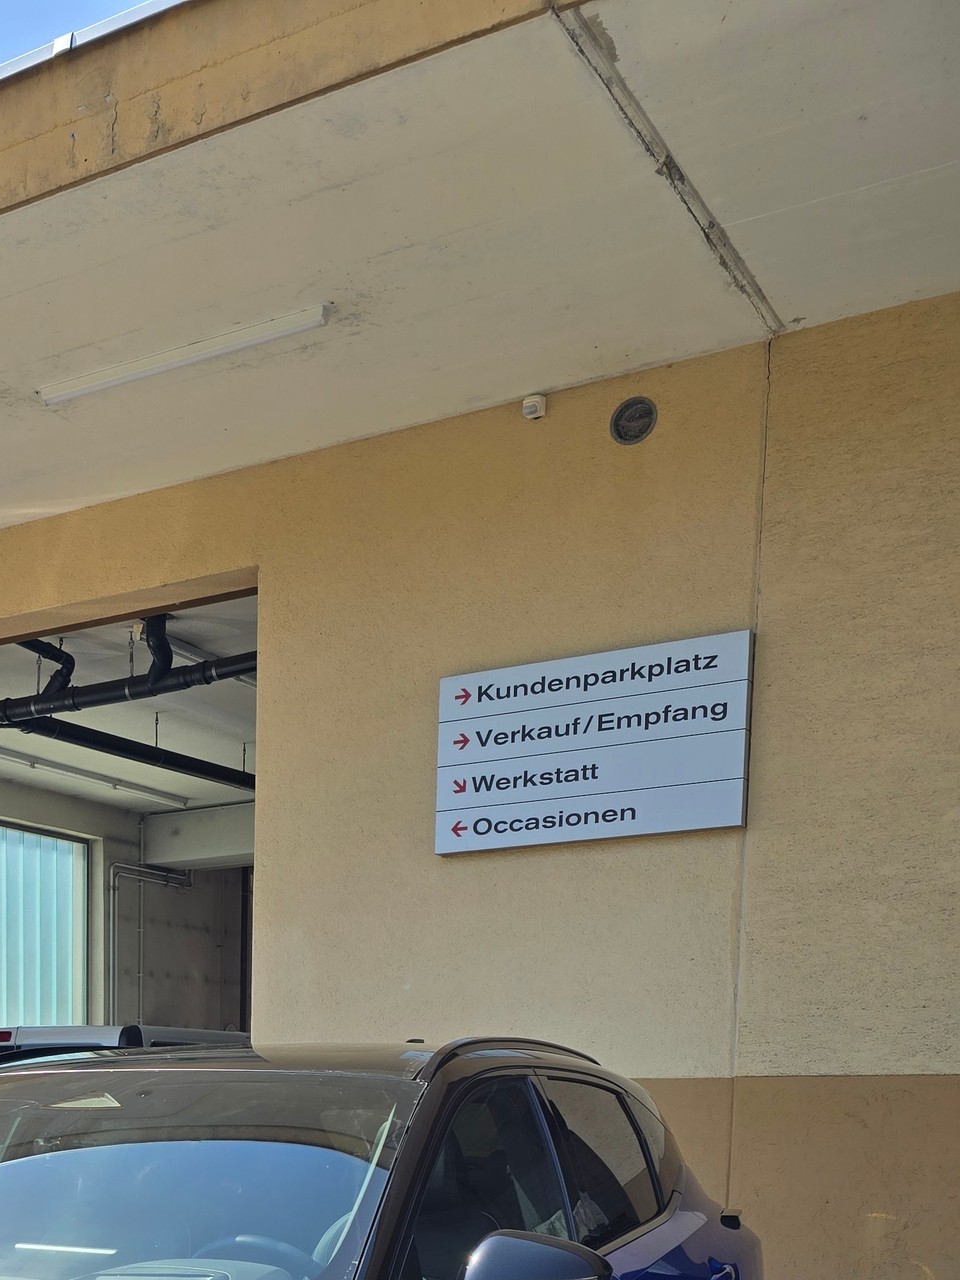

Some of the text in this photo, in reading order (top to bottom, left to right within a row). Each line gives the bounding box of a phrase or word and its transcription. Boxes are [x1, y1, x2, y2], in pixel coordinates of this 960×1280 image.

[476, 652, 719, 703] Kundenparkplatz
[475, 701, 729, 748] Verkauf/Empfang
[471, 763, 599, 793] Werkstatt
[472, 806, 637, 836] Occasionen
